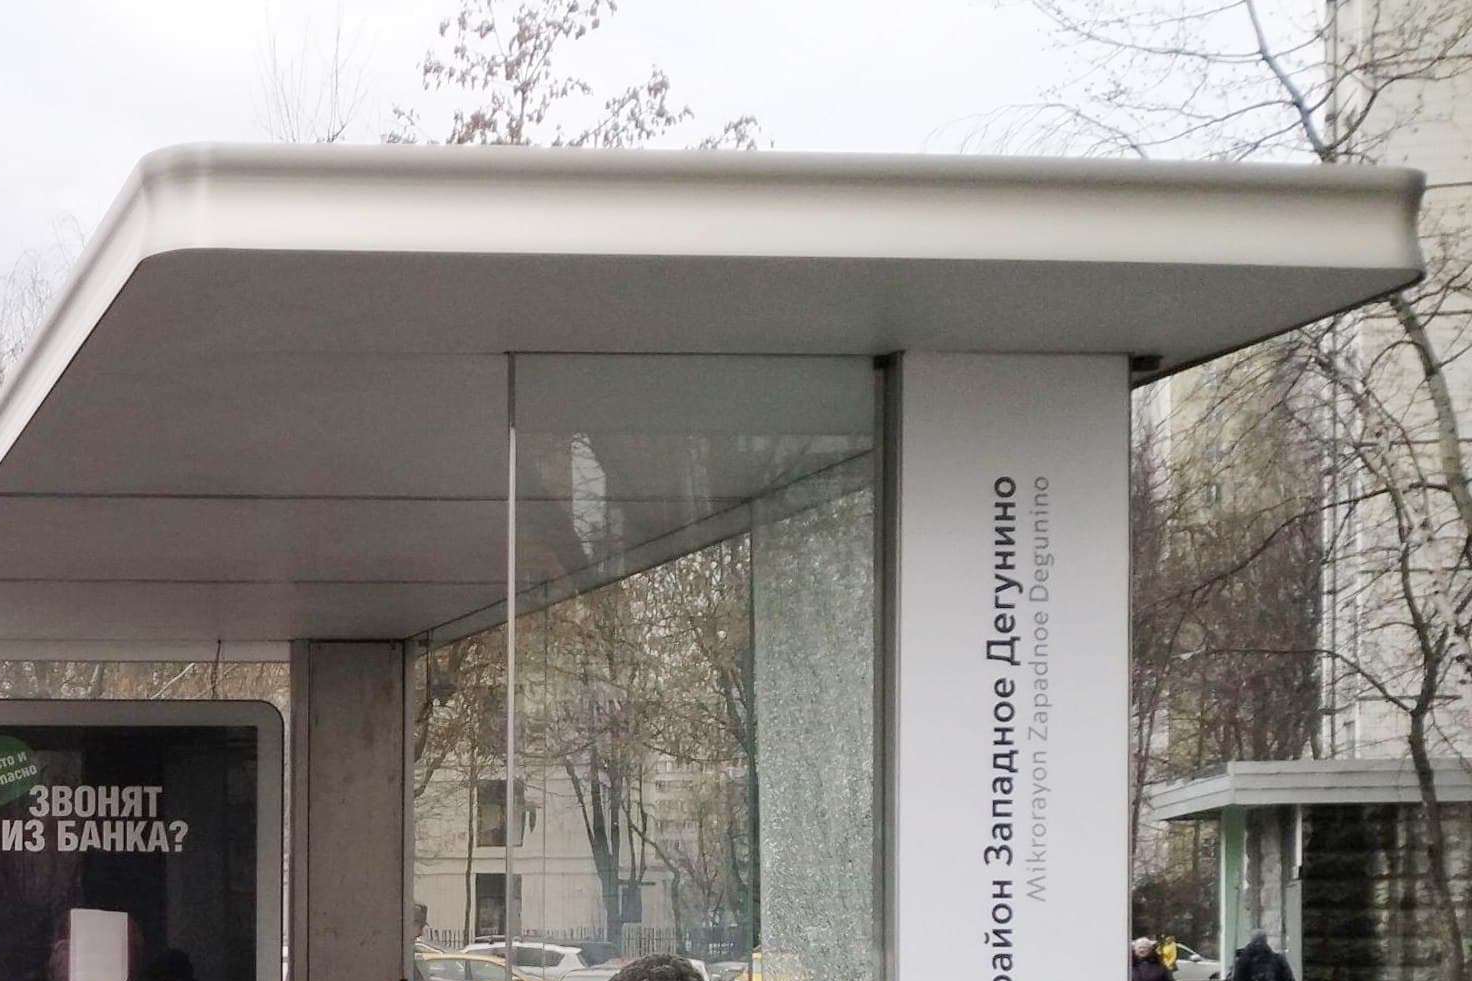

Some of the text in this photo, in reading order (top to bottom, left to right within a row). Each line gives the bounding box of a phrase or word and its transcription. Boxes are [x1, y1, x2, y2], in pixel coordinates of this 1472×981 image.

[986, 476, 1024, 667] Дегунино
[1025, 476, 1055, 902] Mikrorayon Zapadnoe Degunino
[17, 751, 28, 763] и
[29, 785, 164, 818] ЗВОНЯТ
[984, 677, 1019, 866] Западное
[1, 819, 190, 853] ИЗ БАНКА?
